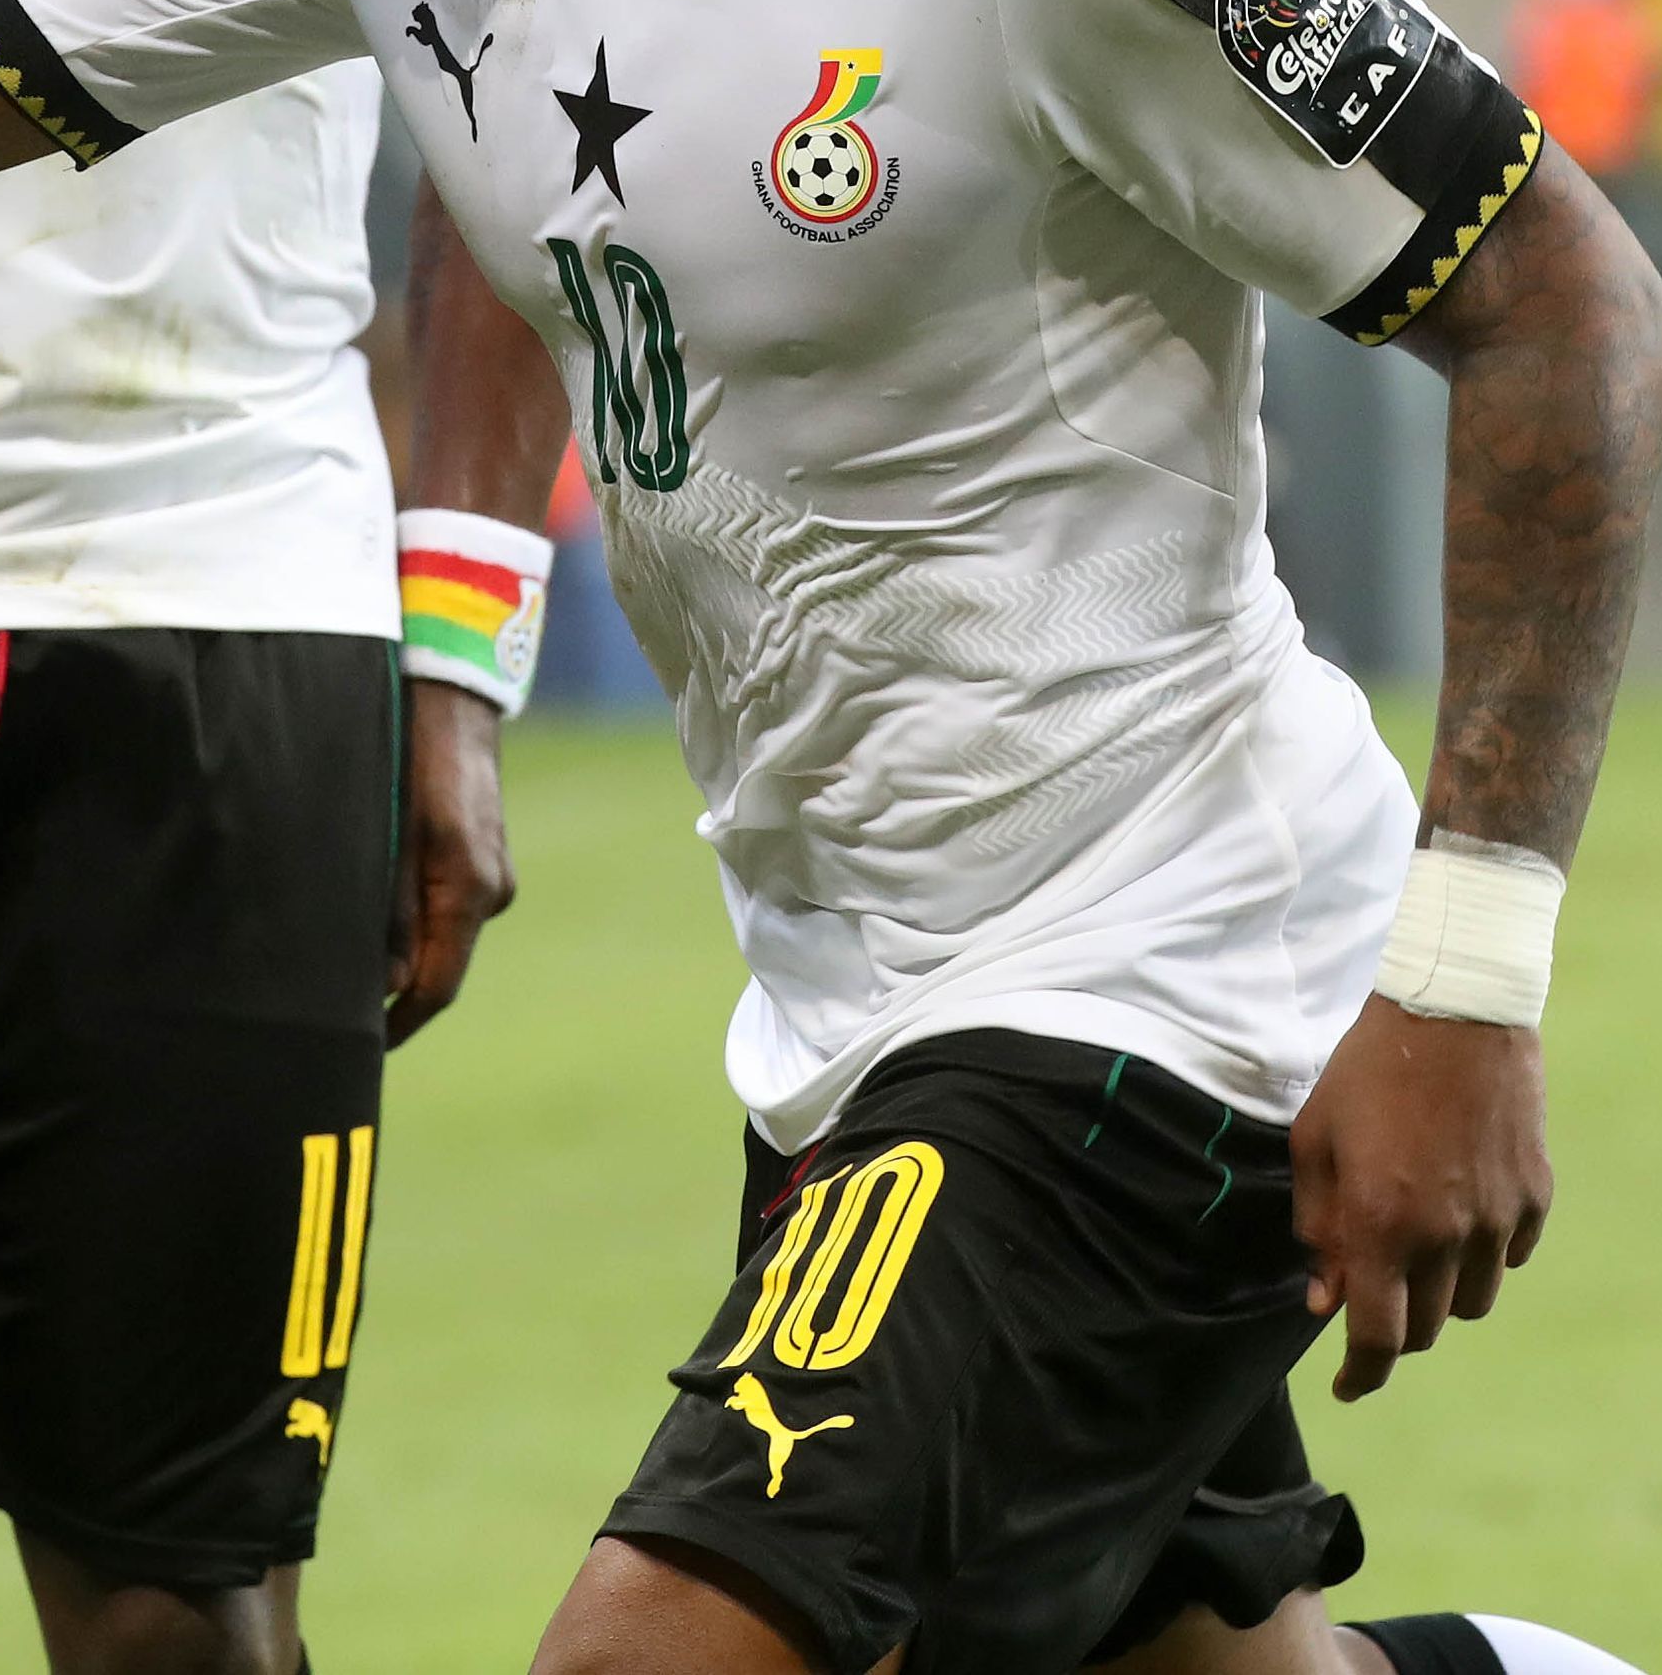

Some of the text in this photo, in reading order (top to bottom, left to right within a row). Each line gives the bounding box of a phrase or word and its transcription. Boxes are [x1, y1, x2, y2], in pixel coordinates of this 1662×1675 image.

[1339, 23, 1411, 127] CAF
[751, 156, 901, 244] GHANA FOOTBALL ASSOCIATION
[546, 237, 690, 493] 10
[280, 1125, 375, 1379] 11
[716, 1140, 945, 1371] 10
